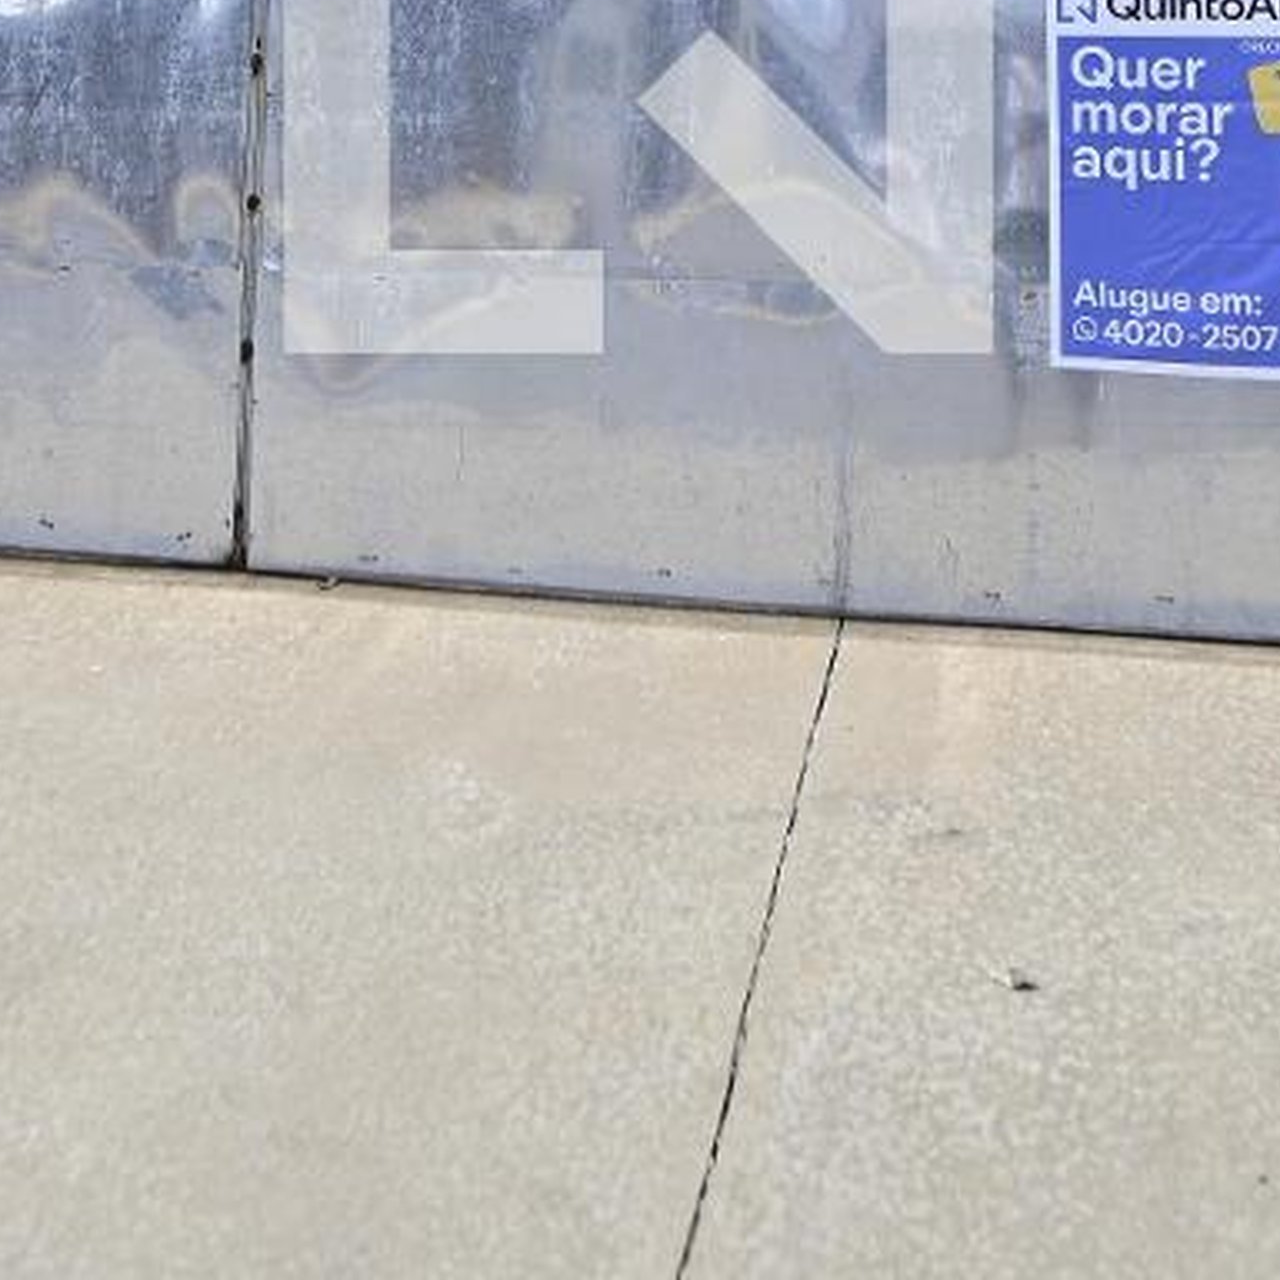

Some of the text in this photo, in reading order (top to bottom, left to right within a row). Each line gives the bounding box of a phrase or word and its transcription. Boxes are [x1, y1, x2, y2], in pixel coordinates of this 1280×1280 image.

[1071, 45, 1206, 91] Quer
[1072, 100, 1235, 136] morar
[1072, 137, 1221, 192] aqui?
[1073, 280, 1263, 318] Alugue em:
